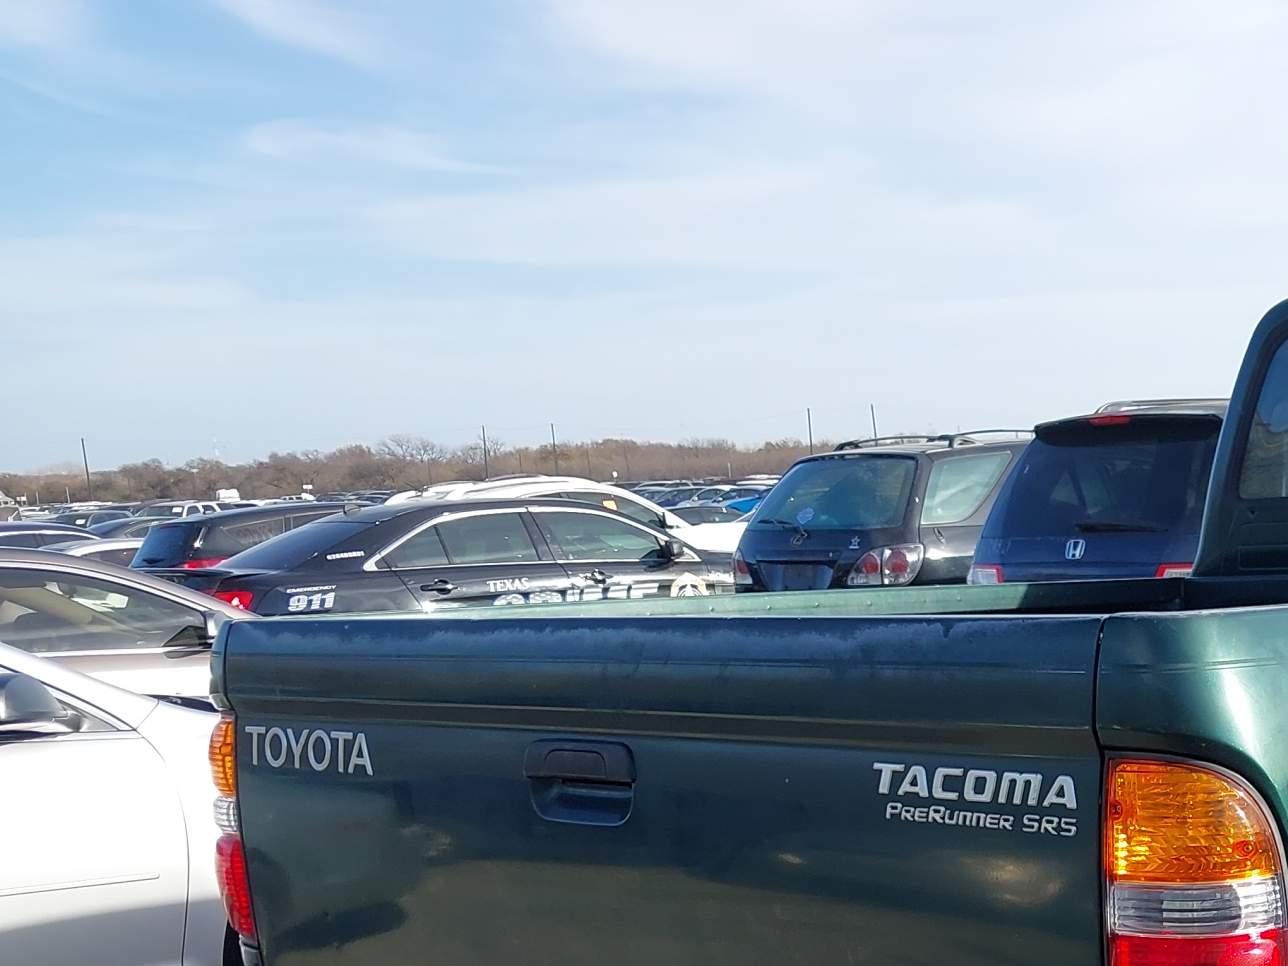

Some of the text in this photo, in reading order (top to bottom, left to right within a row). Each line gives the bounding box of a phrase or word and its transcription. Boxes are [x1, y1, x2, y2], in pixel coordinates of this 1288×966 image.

[287, 592, 336, 612] 911
[487, 578, 529, 593] TEXAS
[245, 725, 373, 776] TOYOTA
[873, 762, 1078, 810] TACOMA
